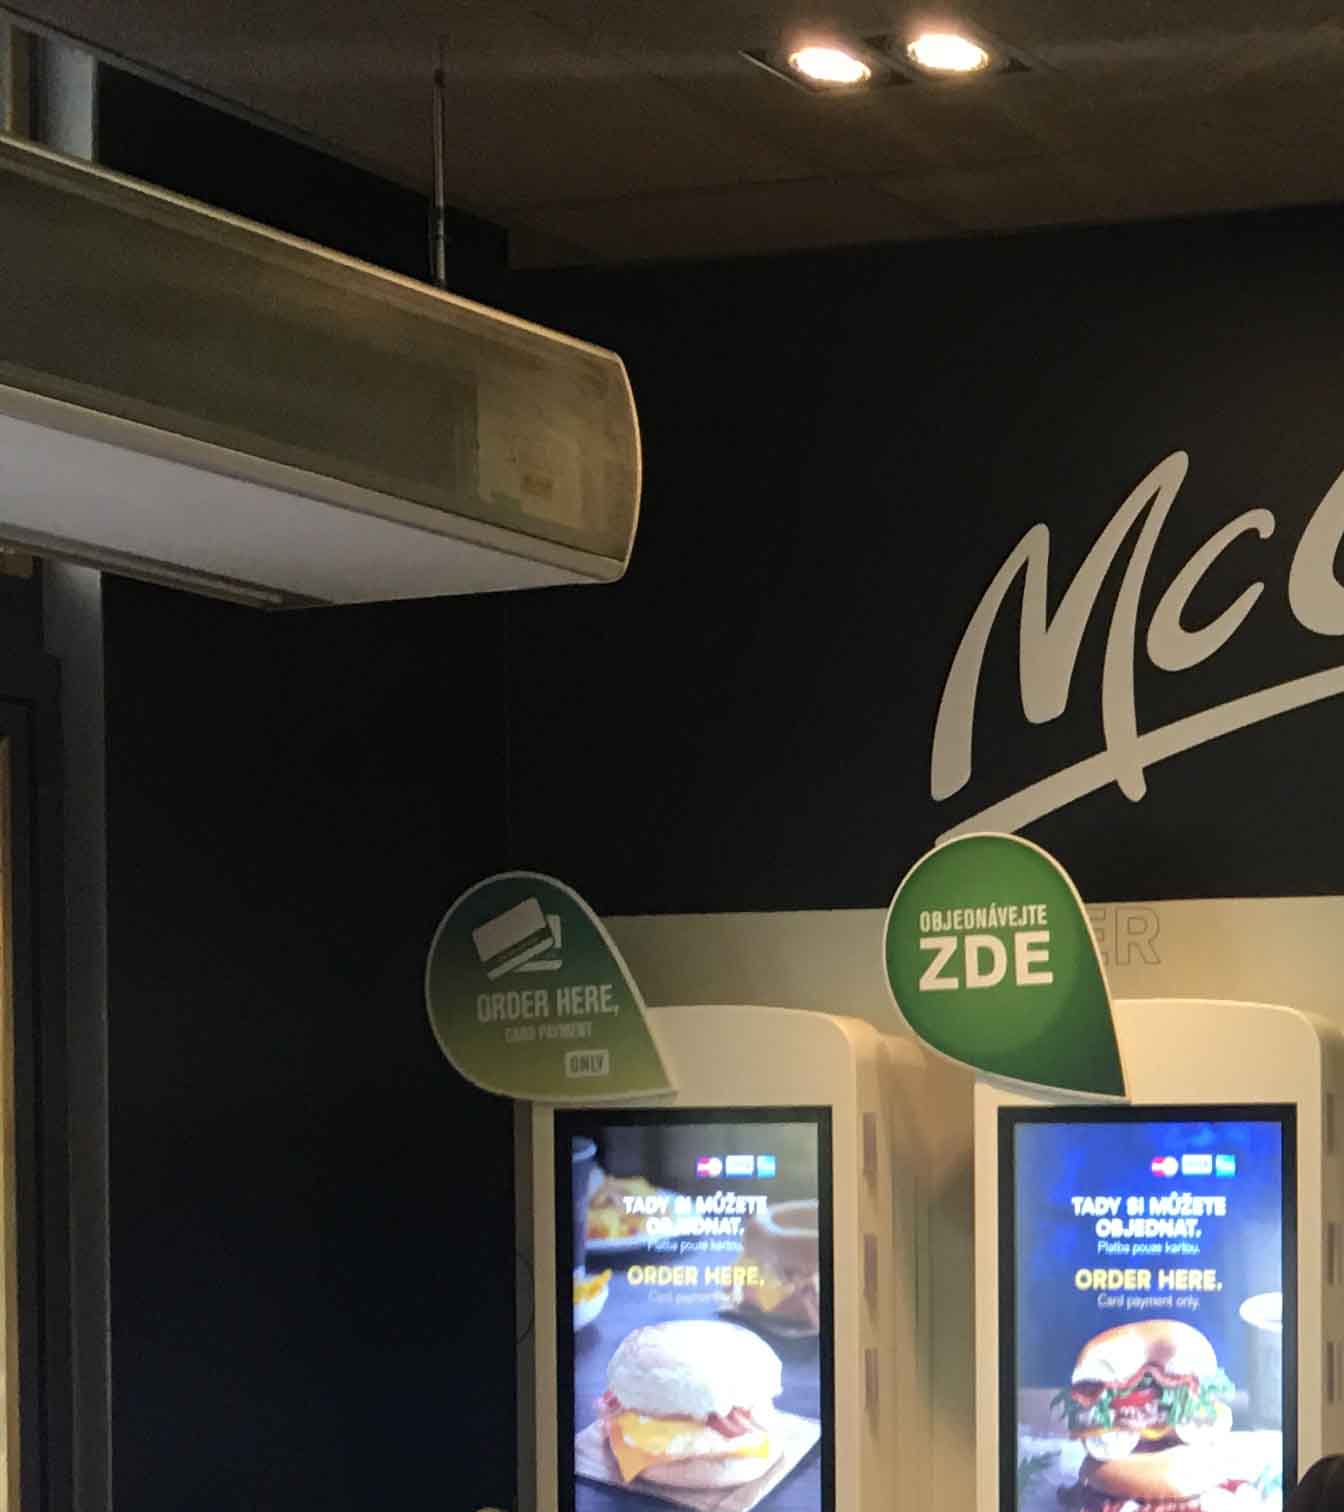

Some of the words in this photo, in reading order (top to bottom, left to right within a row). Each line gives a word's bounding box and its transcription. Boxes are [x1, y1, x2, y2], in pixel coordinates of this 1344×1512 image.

[919, 903, 1047, 932] OBJEDNÁVEJTE
[919, 930, 1053, 991] ZDE
[477, 990, 549, 1023] ORDER
[557, 984, 620, 1016] HERE,
[570, 1055, 606, 1072] ONLY
[623, 1196, 669, 1214] TADY
[1071, 1196, 1122, 1216] TADY
[627, 1265, 698, 1286] ORDER
[1075, 1268, 1151, 1291] ORDER
[1097, 1294, 1123, 1307] Card
[1127, 1296, 1173, 1310] payment
